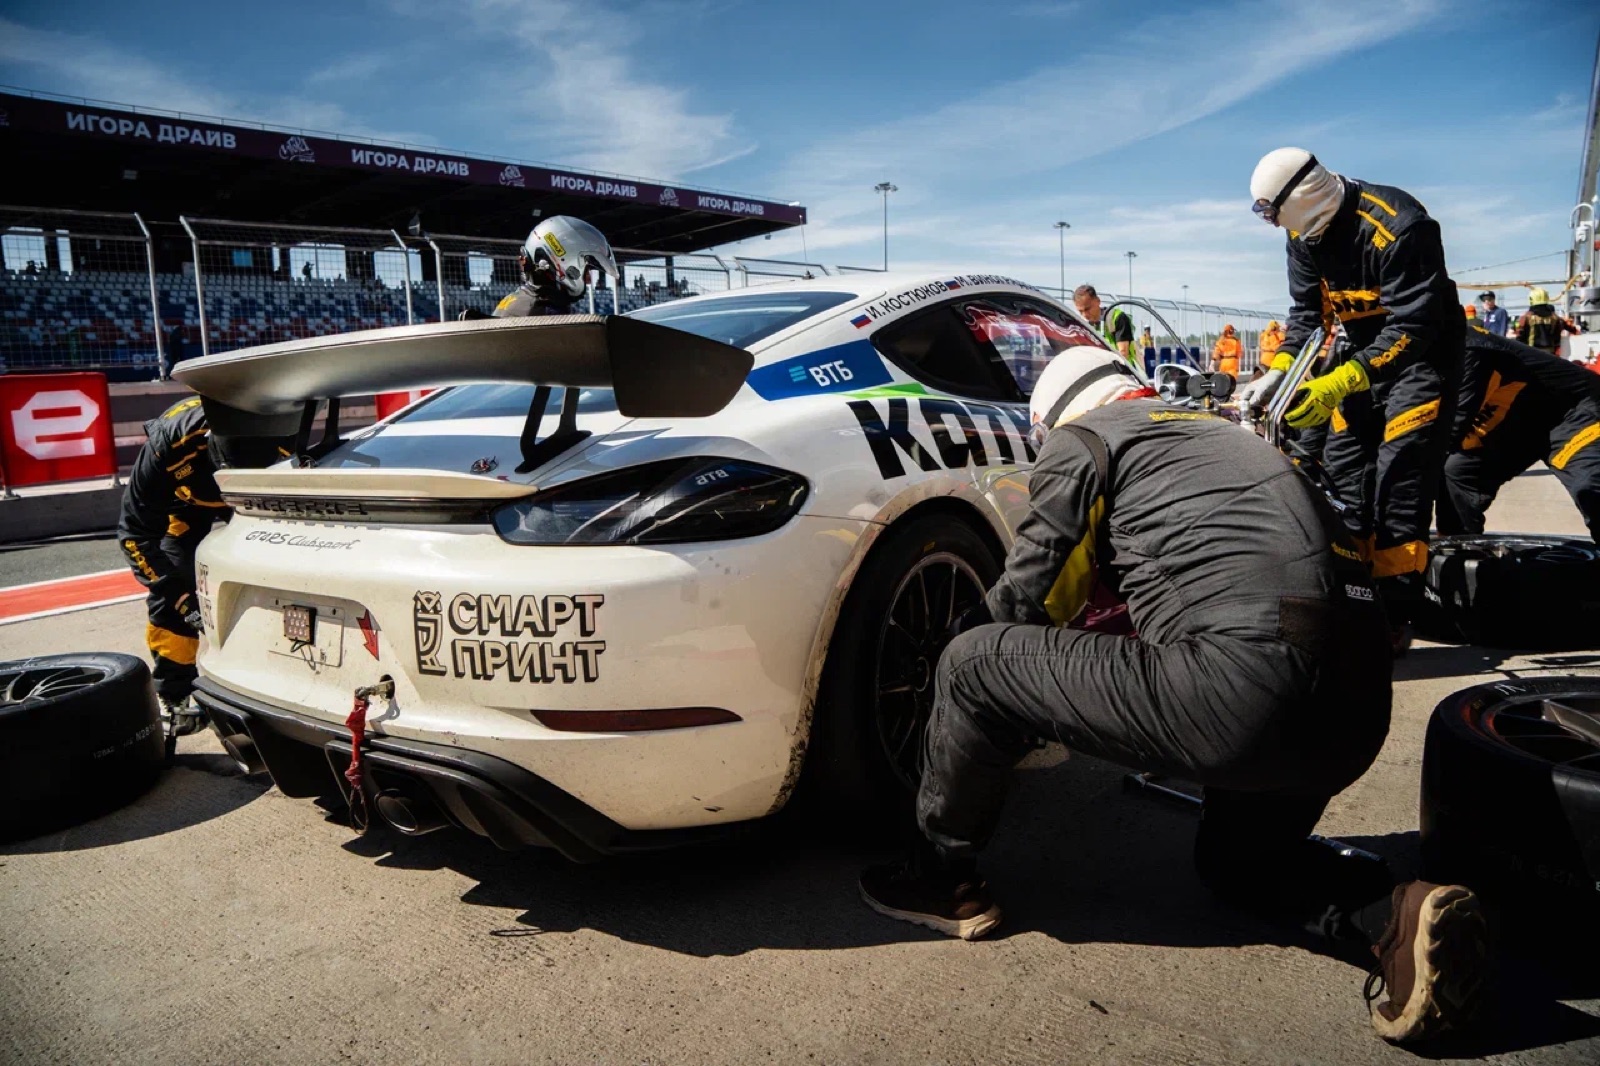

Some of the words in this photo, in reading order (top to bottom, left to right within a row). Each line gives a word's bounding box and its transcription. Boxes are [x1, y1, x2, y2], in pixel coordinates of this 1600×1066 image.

[66, 111, 151, 139] ИГОРА
[157, 124, 237, 149] ДРАЙВ
[351, 149, 409, 169] ИГОРА
[413, 157, 470, 176] ДРАЙВ
[550, 174, 595, 192] ИГОРА
[698, 195, 730, 210] ИГОРА
[809, 360, 854, 387] ВТБ
[287, 535, 361, 551] Clubsport
[1344, 584, 1374, 600] sparco
[449, 592, 605, 637] СМАРТ
[451, 639, 606, 683] ПРИНТ
